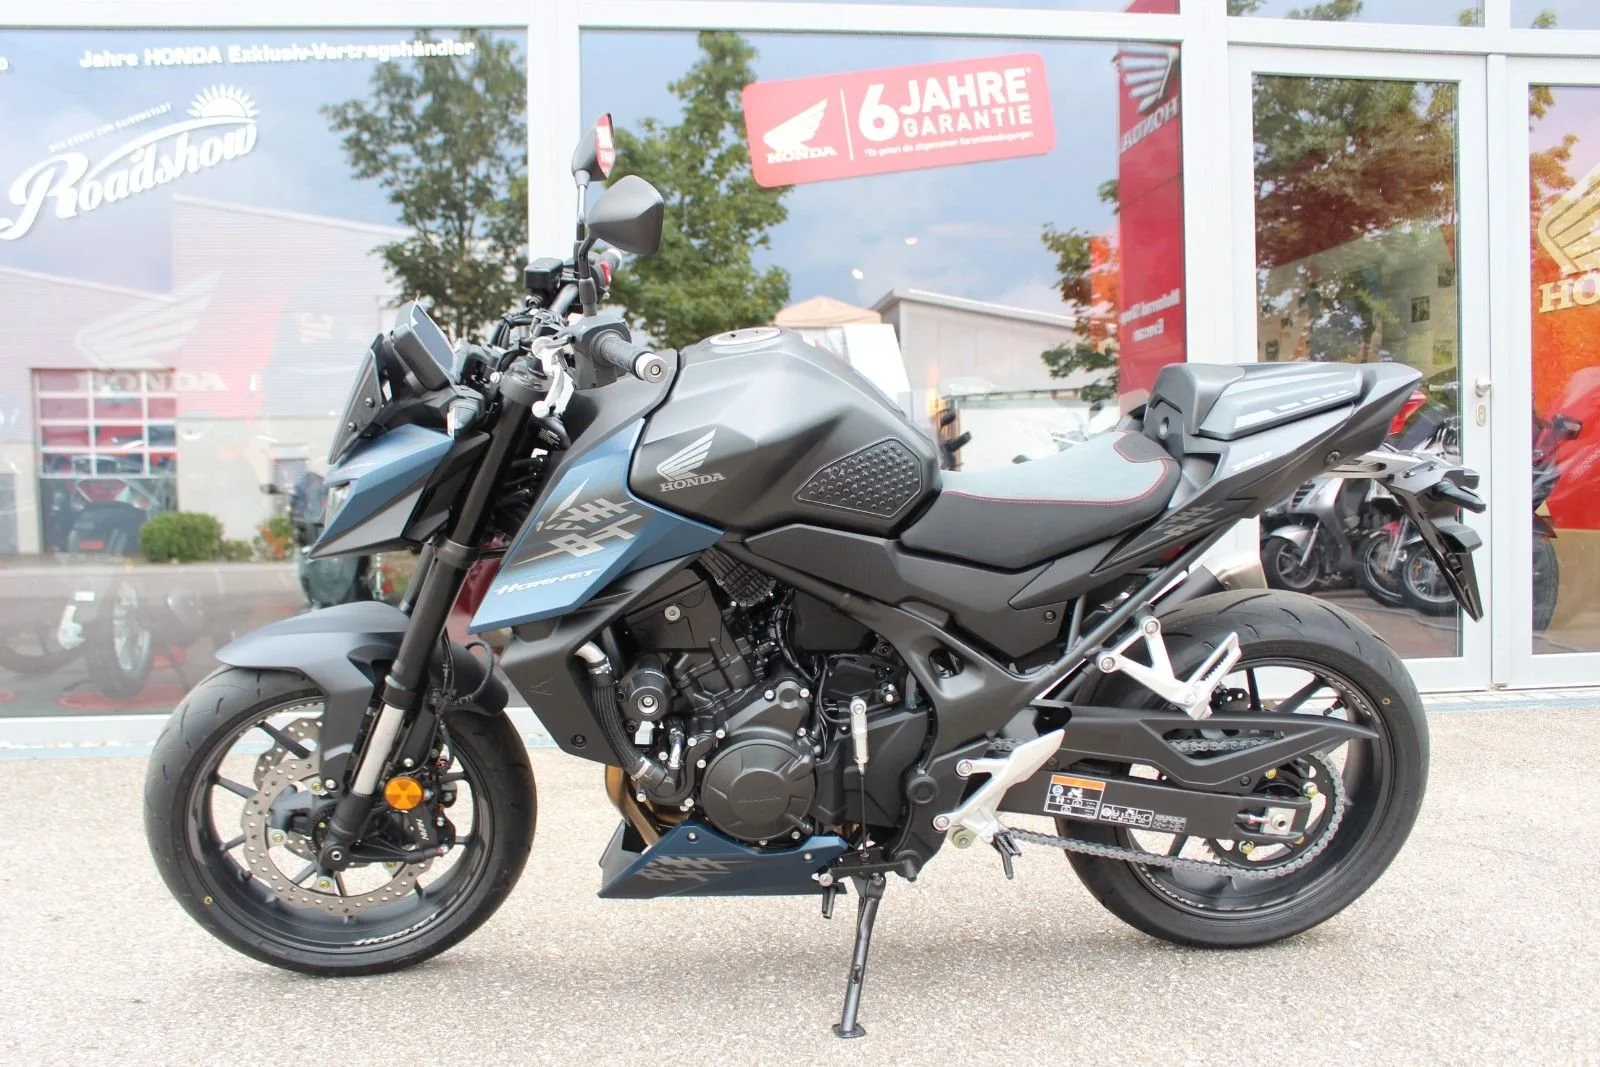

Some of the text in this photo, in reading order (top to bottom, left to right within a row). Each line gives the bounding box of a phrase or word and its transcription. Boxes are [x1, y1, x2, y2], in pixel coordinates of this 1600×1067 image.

[79, 50, 139, 68] Jahre
[143, 45, 223, 65] HONDA
[858, 83, 900, 142] 6
[903, 105, 1033, 138] GARANTIE
[765, 146, 839, 164] HONDA
[0, 123, 258, 240] Roadshow
[659, 472, 726, 492] HONDA
